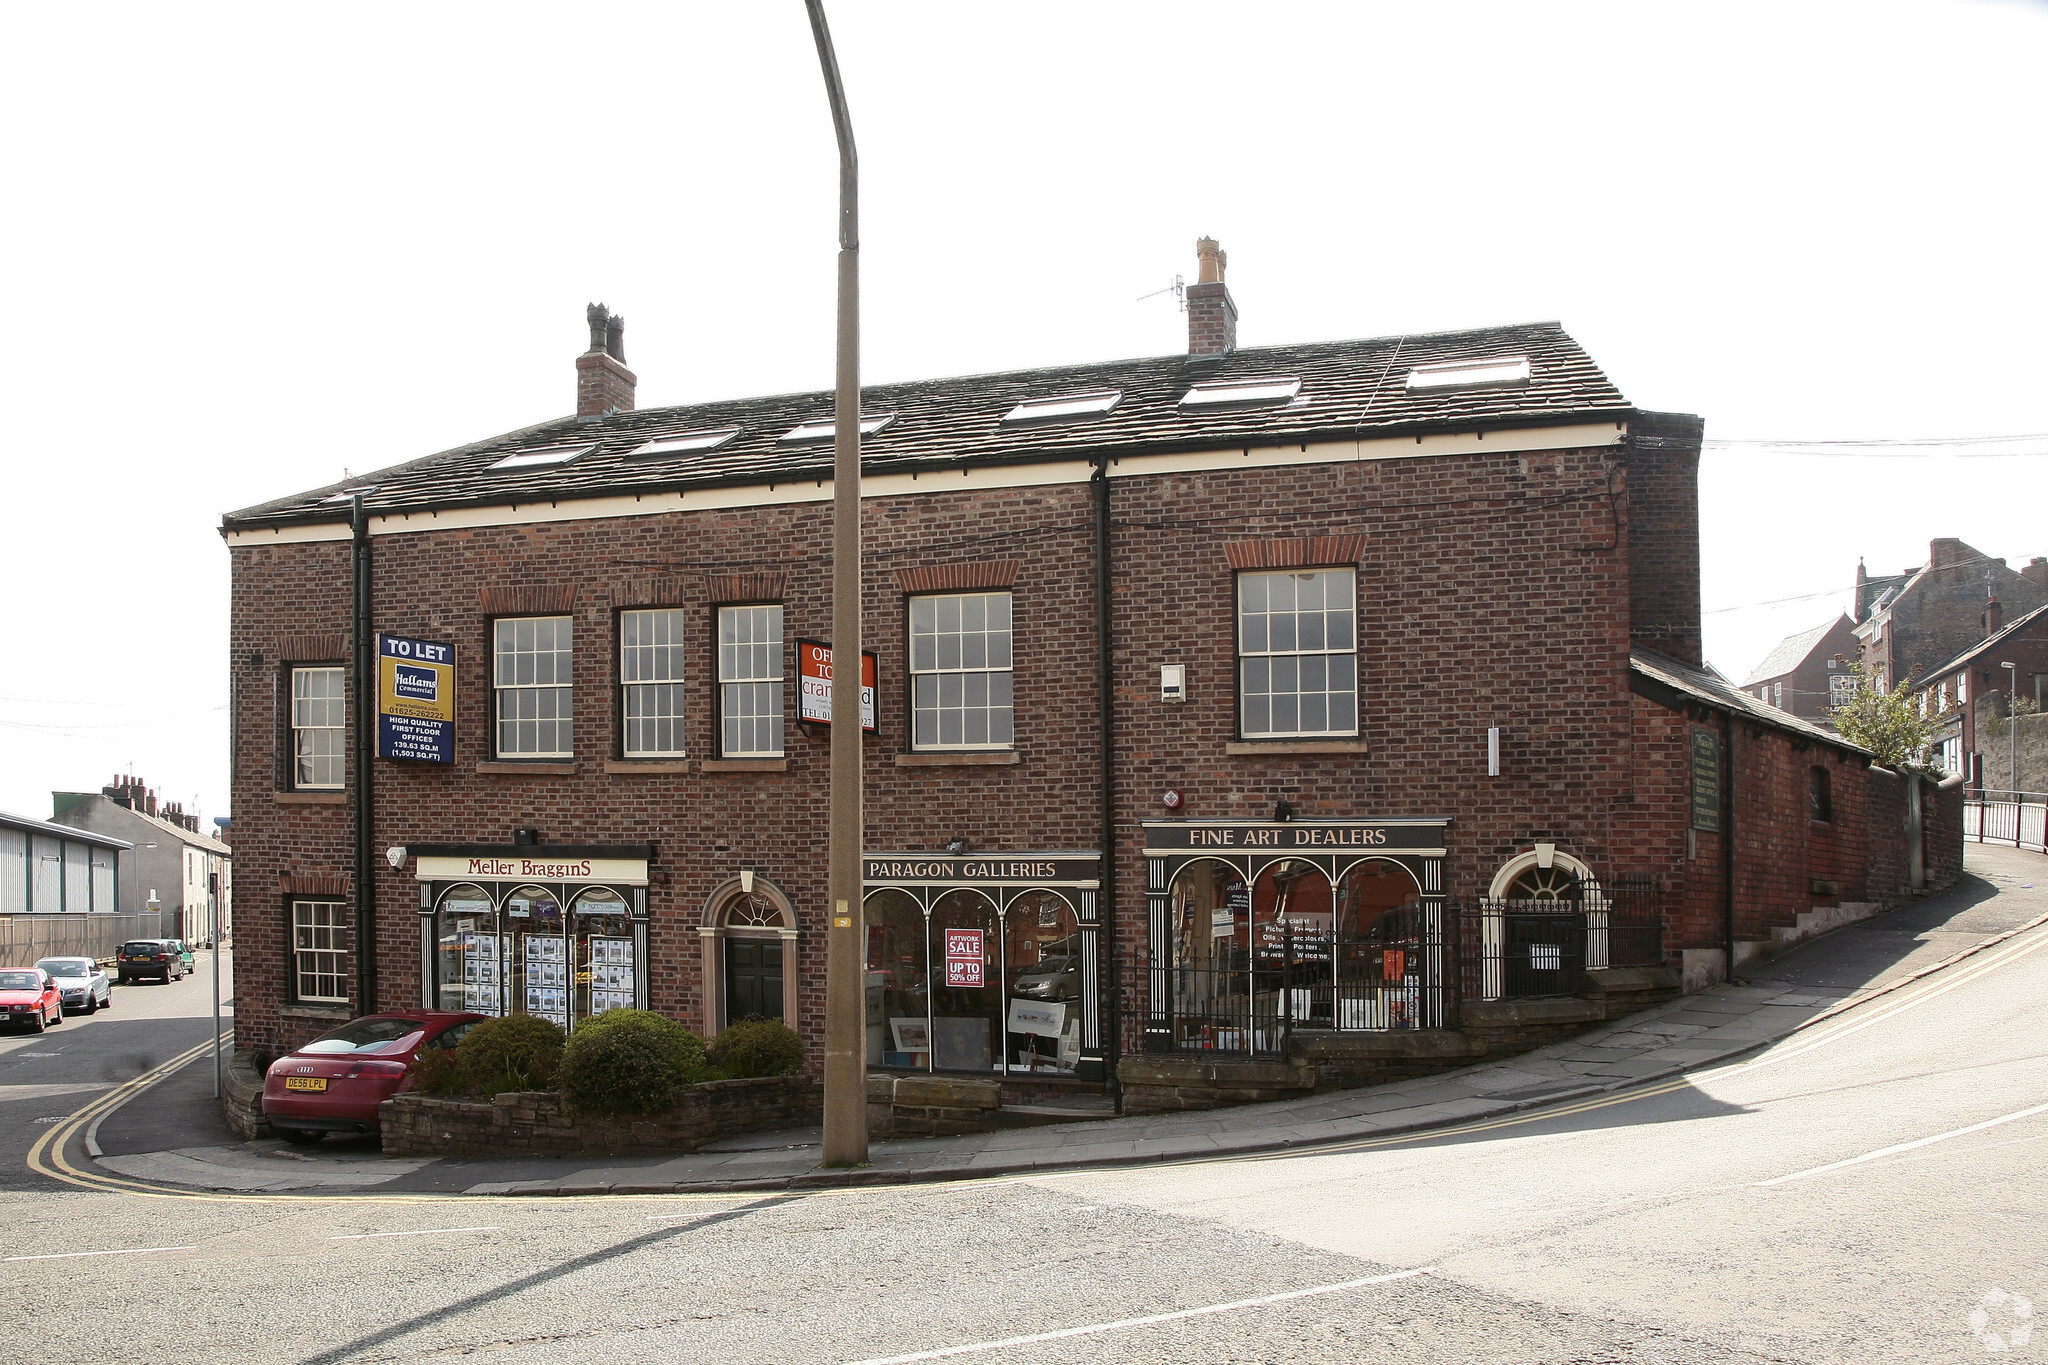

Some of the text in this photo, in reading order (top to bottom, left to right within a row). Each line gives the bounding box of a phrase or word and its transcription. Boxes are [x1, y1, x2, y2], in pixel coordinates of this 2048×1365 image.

[388, 639, 446, 660] TO LET
[396, 673, 437, 688] Hallams
[399, 685, 432, 694] Commercial
[389, 706, 444, 719] 01625-262222
[390, 717, 442, 729] HIGH QUALITY
[392, 725, 440, 736] FIRST FLOOR
[402, 734, 433, 743] OFFICES
[394, 742, 438, 752] 139.63 SQ.M
[416, 752, 440, 761] SQ.FT)
[1190, 829, 1386, 845] FINE ART DEALERS
[468, 859, 514, 875] Meller
[869, 862, 1056, 877] PARAGON GALLERIES
[950, 942, 979, 953] SALE
[950, 963, 979, 973] UP TO
[288, 1078, 323, 1088] DE56 LPL
